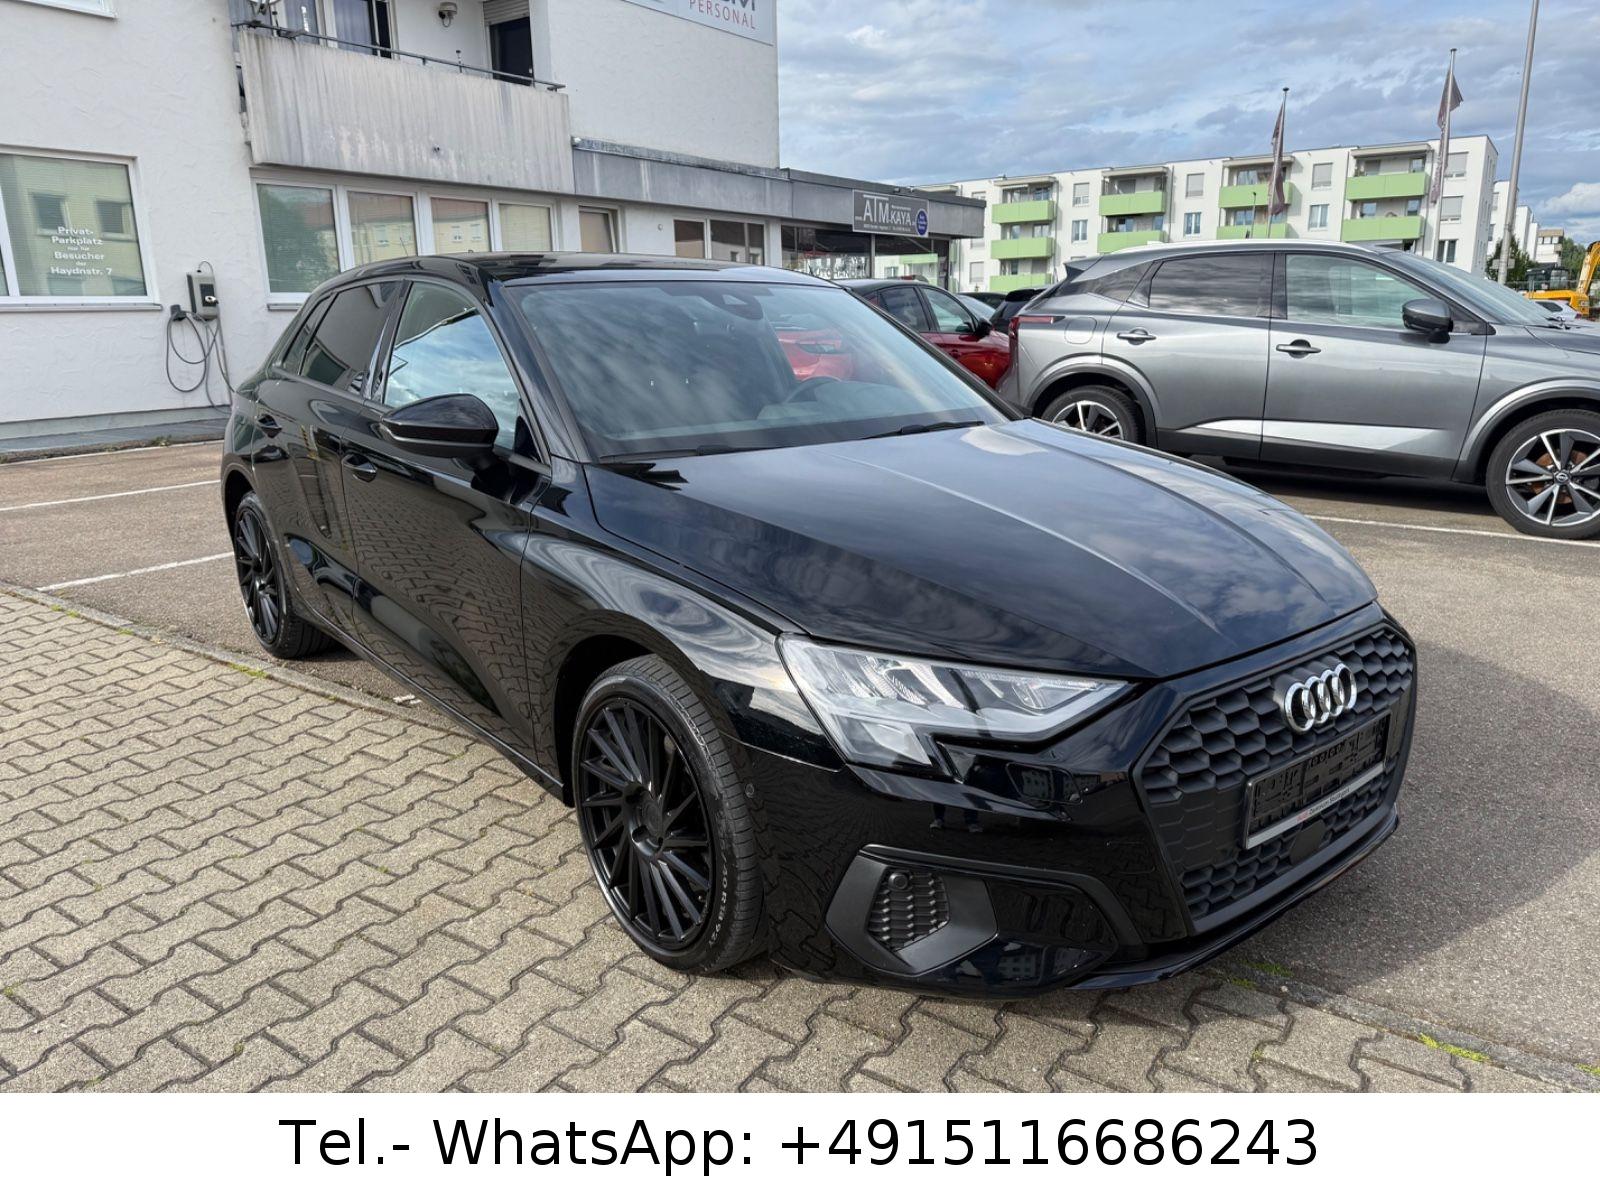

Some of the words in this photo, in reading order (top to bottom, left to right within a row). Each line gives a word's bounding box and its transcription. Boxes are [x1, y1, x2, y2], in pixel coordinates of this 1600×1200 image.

[689, 0, 756, 29] PERSONAL
[57, 226, 94, 235] Privat-
[51, 235, 103, 246] Parkplatz
[54, 251, 105, 260] Besucher
[50, 266, 103, 276] Haydnstr.
[105, 267, 112, 275] 7
